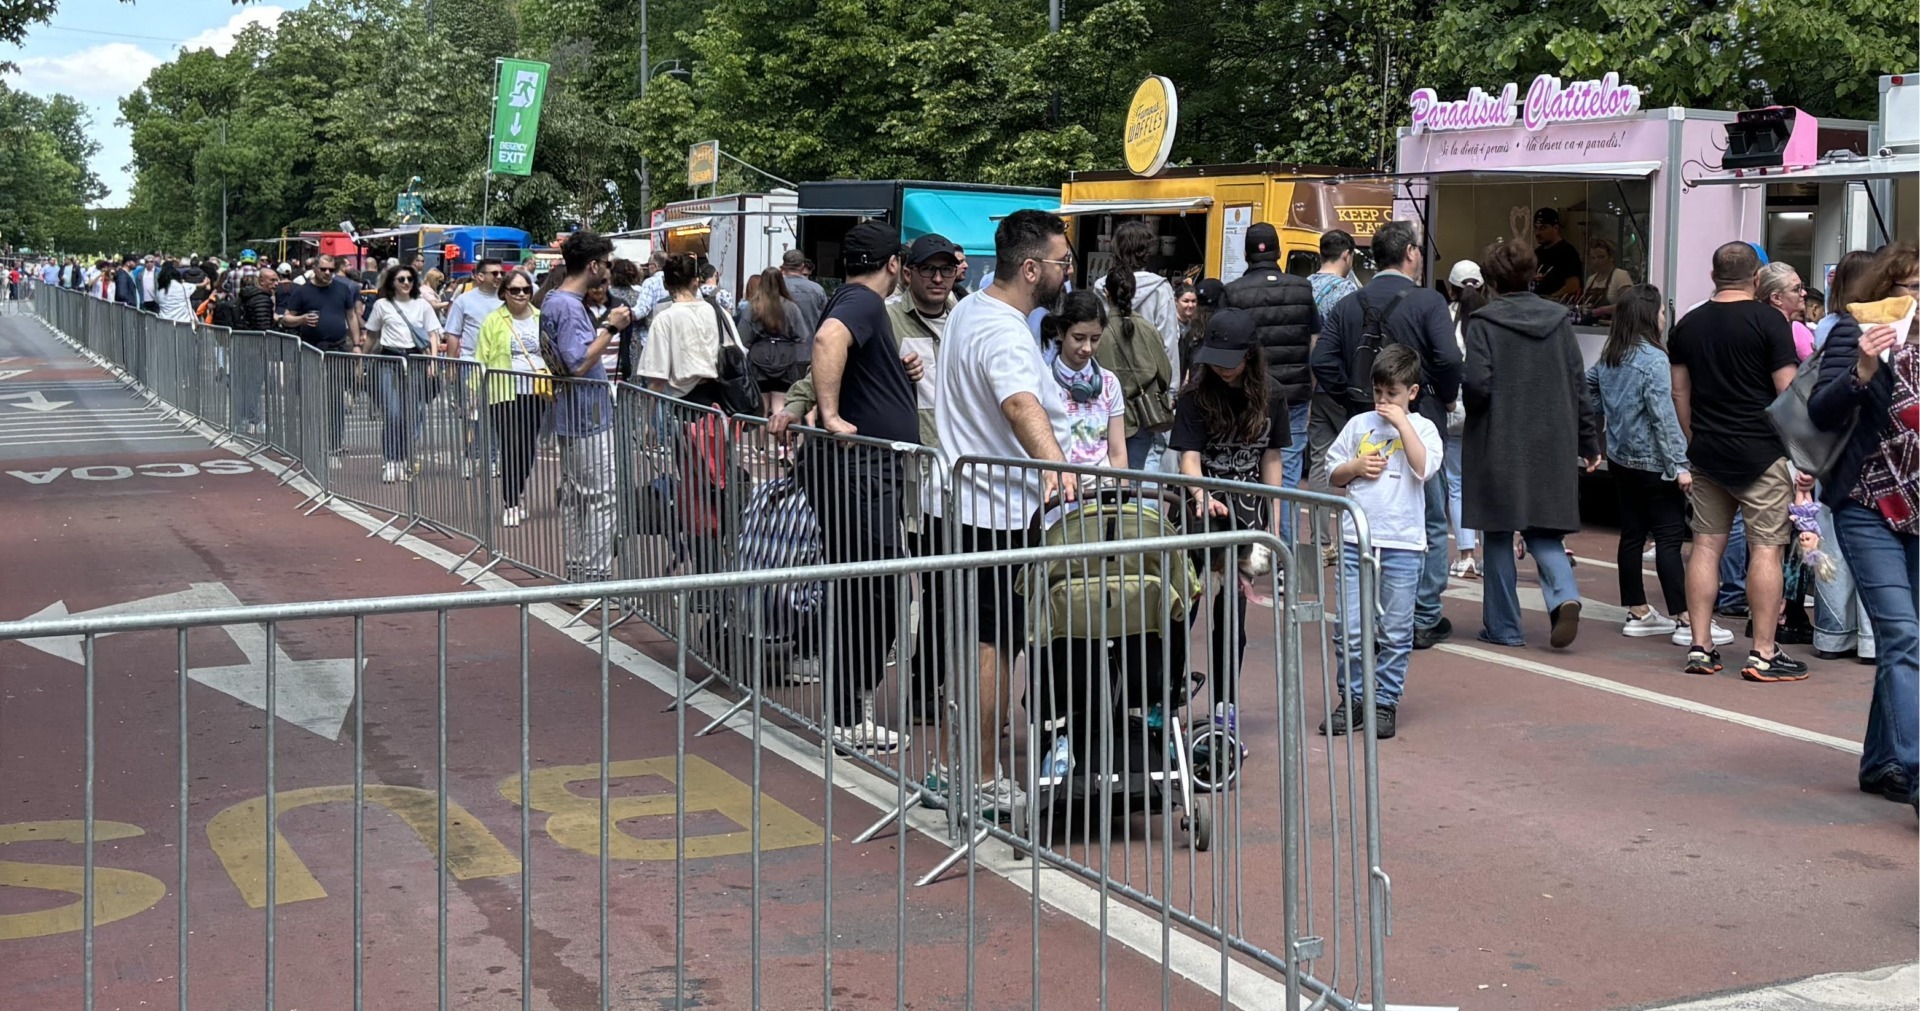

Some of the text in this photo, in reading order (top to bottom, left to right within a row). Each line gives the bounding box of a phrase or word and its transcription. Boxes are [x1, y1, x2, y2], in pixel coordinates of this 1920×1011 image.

[1411, 75, 1634, 135] Paradisul Clatitelor
[1128, 110, 1164, 144] WAFFLES
[498, 150, 527, 164] EXIT
[1450, 140, 1458, 155] la
[1484, 142, 1509, 160] permis
[1539, 135, 1562, 151] desert
[1583, 131, 1626, 156] paradis!
[1336, 209, 1379, 221] KEEP
